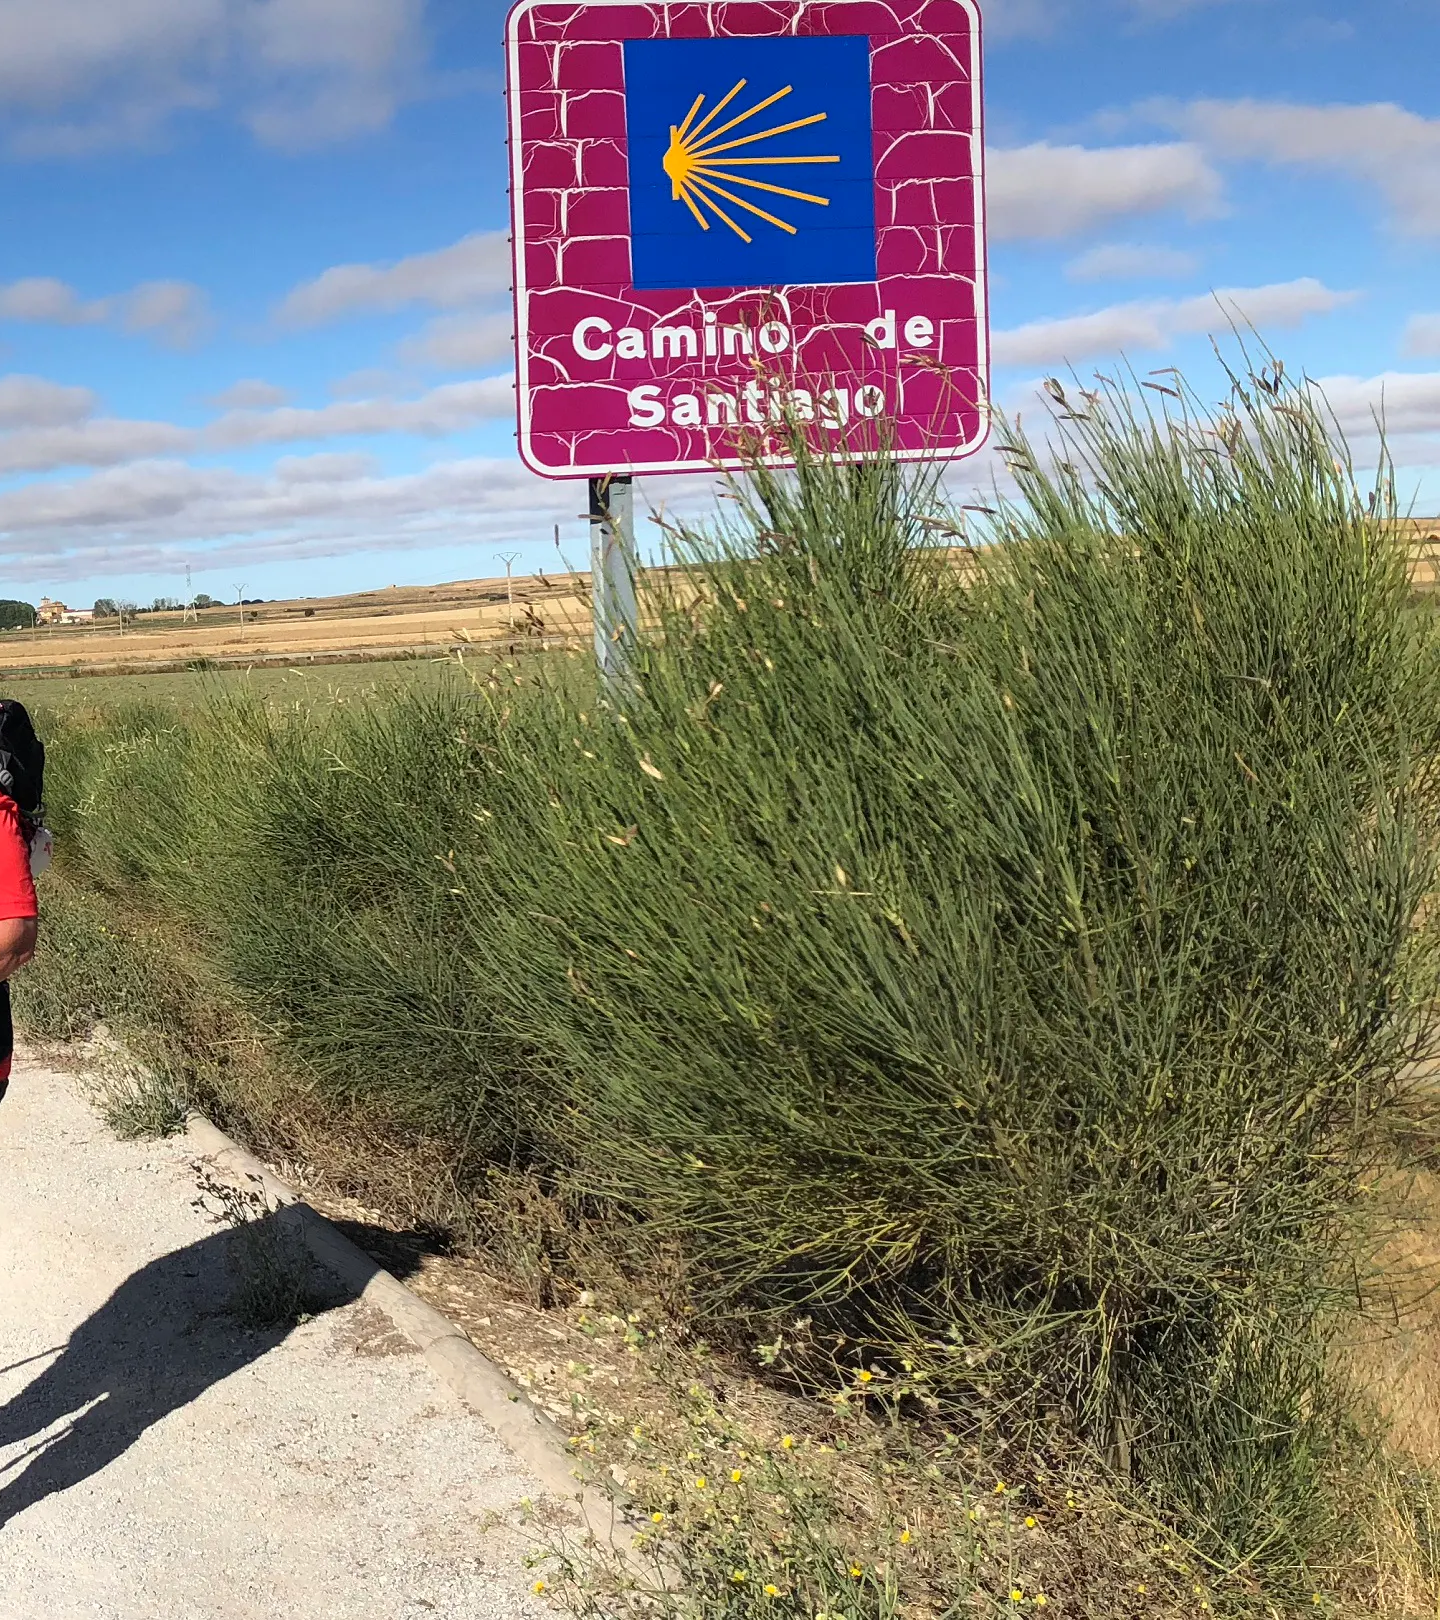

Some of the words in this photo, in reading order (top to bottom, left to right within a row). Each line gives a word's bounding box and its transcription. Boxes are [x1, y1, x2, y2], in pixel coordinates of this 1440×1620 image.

[572, 311, 791, 361] Camino
[864, 309, 934, 350] de
[628, 377, 885, 429] Santiago
